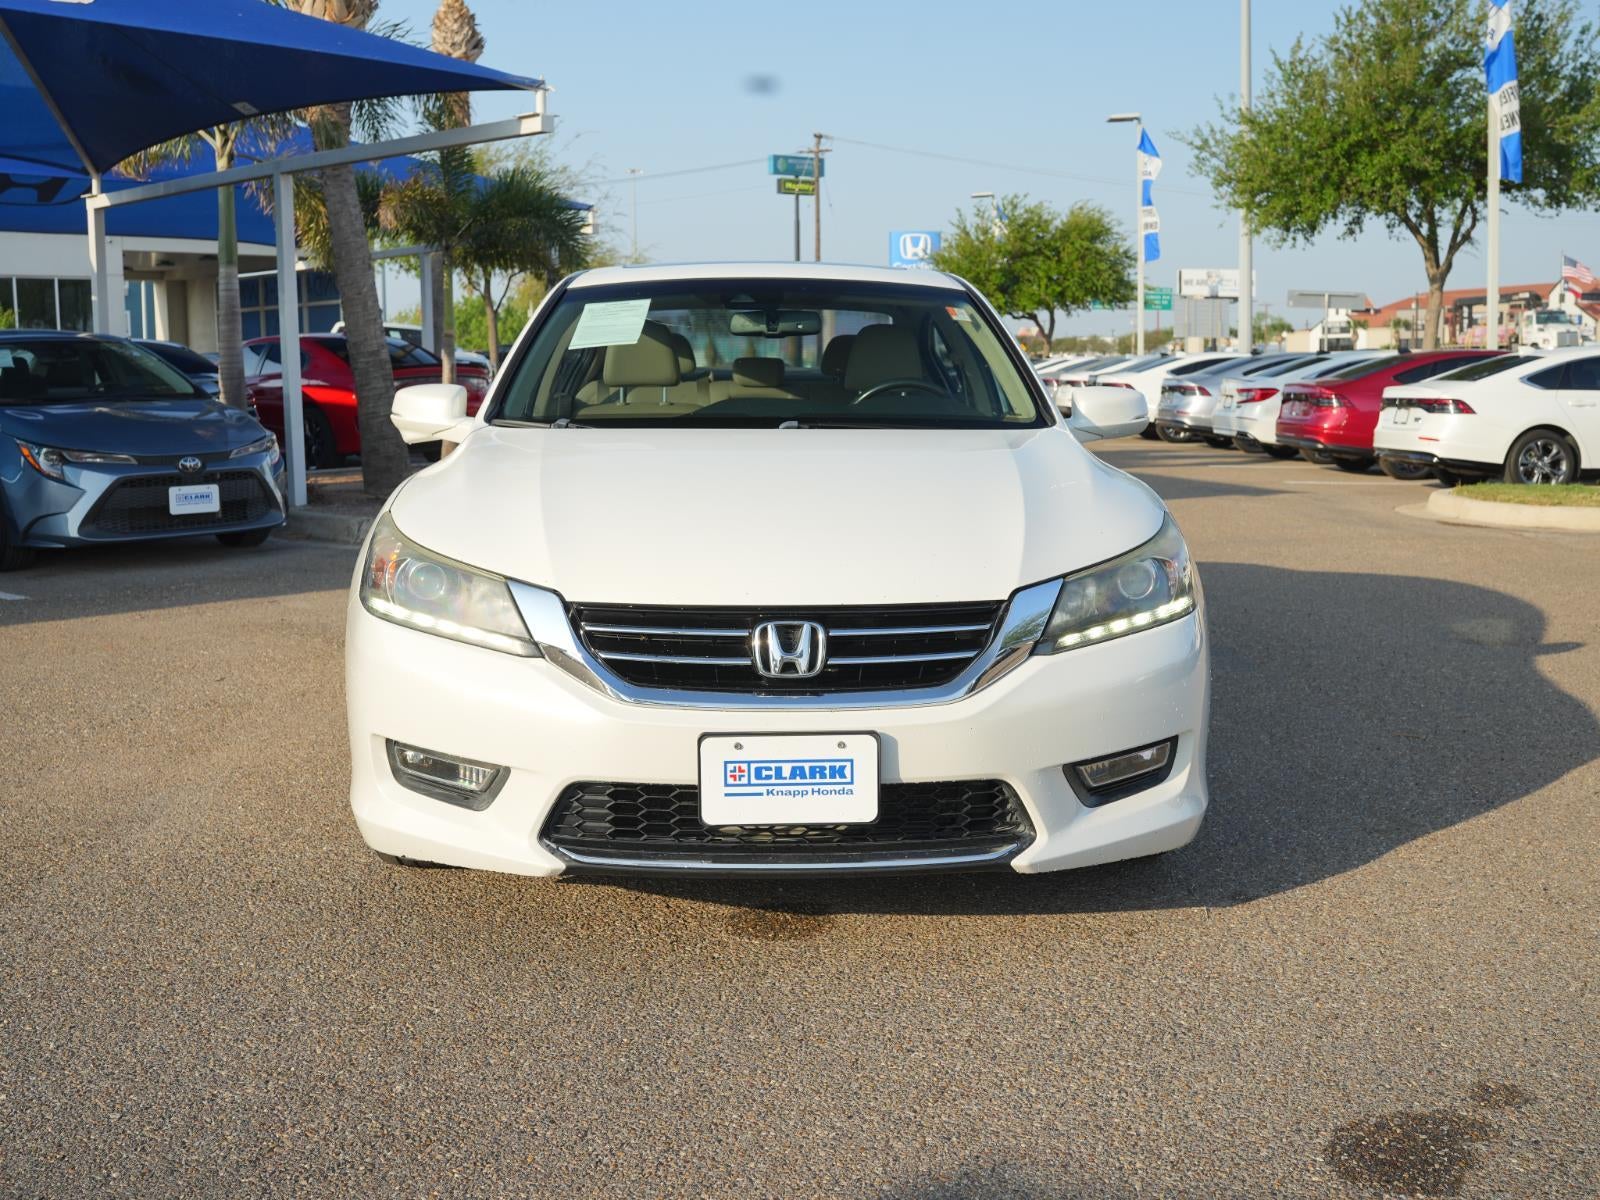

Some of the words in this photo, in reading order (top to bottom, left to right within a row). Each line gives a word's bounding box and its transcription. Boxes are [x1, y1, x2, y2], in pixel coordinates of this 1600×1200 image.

[754, 764, 848, 782] CLARK
[766, 788, 809, 798] Knapp
[811, 787, 854, 796] Honda
